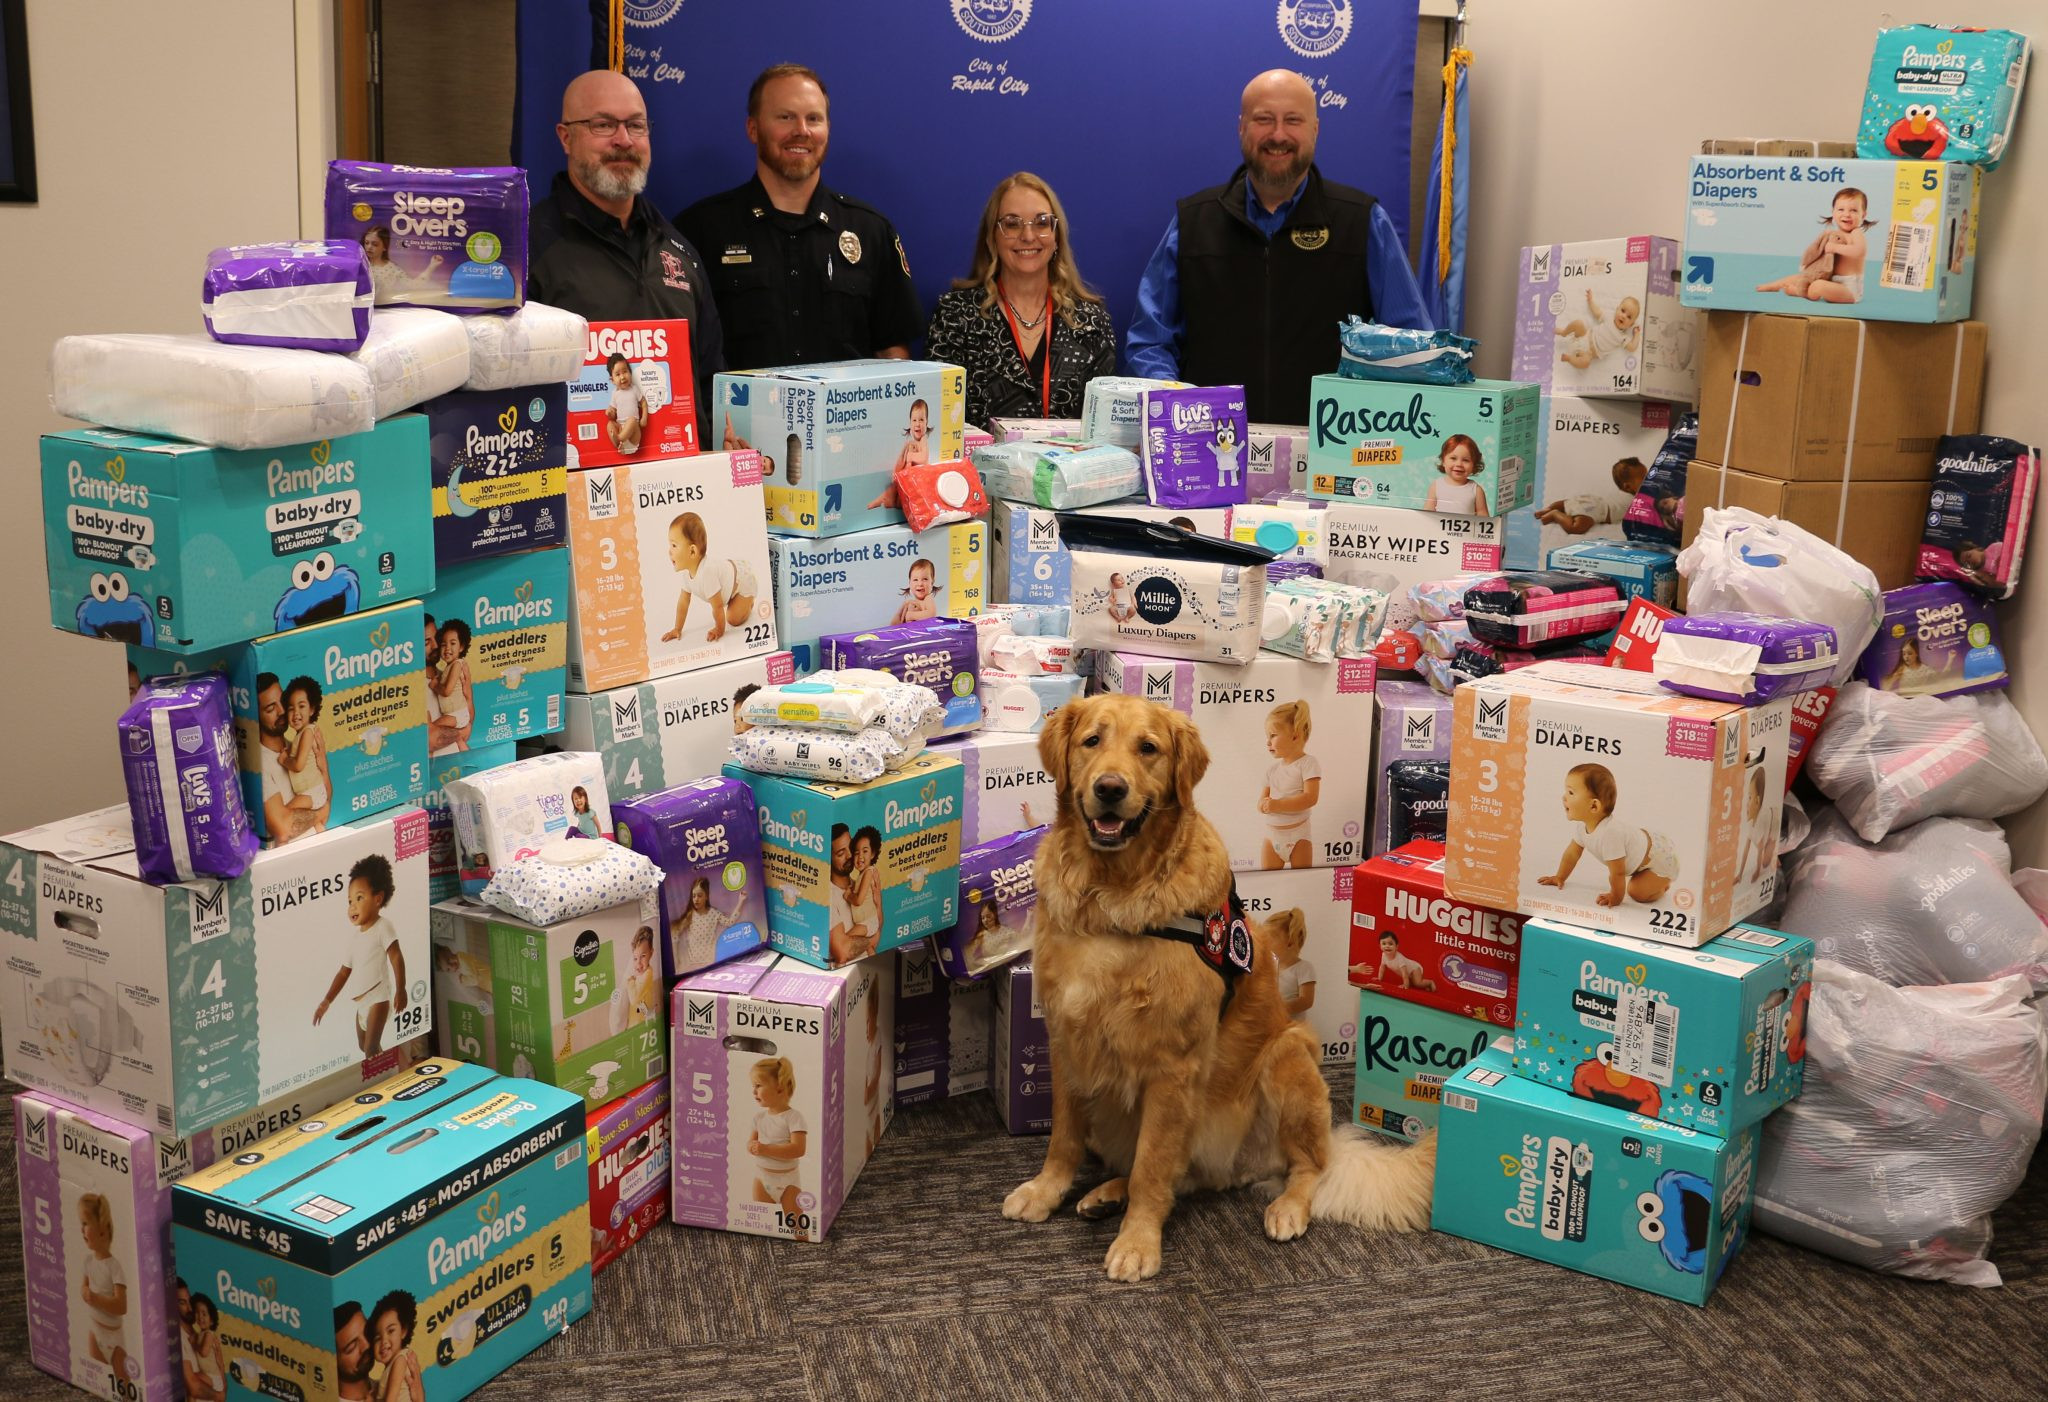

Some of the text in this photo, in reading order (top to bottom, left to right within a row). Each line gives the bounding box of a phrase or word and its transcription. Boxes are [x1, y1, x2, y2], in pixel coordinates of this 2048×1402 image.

[961, 11, 1022, 35] SOUTH DAKOTA
[1287, 27, 1341, 50] SOUTH DAKOTA
[654, 64, 685, 83] City
[969, 58, 1008, 75] City of
[952, 75, 1029, 96] Rapid City
[1320, 90, 1348, 109] City
[1963, 125, 1970, 134] 5
[1693, 163, 1845, 183] Absorbent & Soft
[1922, 169, 1938, 190] 5
[1693, 182, 1757, 199] Diapers
[393, 191, 465, 220] Sleep
[391, 214, 468, 237] Overs
[492, 266, 503, 275] 22
[1532, 294, 1540, 316] 1
[570, 382, 608, 393] SNUGGLERS
[954, 376, 963, 395] 5
[1613, 375, 1632, 387] 164
[826, 380, 916, 406] Absorbent & Soft
[826, 407, 868, 425] Diapers
[1479, 398, 1493, 417] 5
[1317, 392, 1432, 447] Rascals
[1556, 420, 1620, 435] DIAPERS
[466, 425, 533, 457] Pampers
[684, 424, 693, 442] 1
[952, 430, 961, 440] 112
[660, 442, 670, 452] 96
[1364, 440, 1391, 449] PREMIUM
[1357, 450, 1397, 463] DIAPERS
[736, 460, 750, 472] $18
[68, 460, 149, 509] Pampers
[267, 459, 355, 498] Pampers
[541, 473, 548, 485] 5
[638, 481, 673, 492] PREMIUM
[639, 486, 704, 508] DIAPERS
[1377, 484, 1391, 492] 64
[540, 507, 549, 516] 50
[1330, 522, 1378, 532] PREMIUM
[1440, 519, 1495, 534] 1152 12
[968, 533, 979, 553] 5
[1330, 533, 1450, 555] BABY WIPES
[383, 554, 390, 566] 5
[600, 538, 618, 571] 3
[789, 540, 919, 568] Absorbent & Soft
[1329, 550, 1418, 563] FRAGRANCE-FREE
[1466, 551, 1482, 561] $10
[1033, 556, 1052, 579] 6
[1227, 568, 1234, 576] 2
[382, 578, 392, 589] 78
[964, 587, 979, 599] 168
[1140, 591, 1176, 606] Millie
[161, 598, 168, 611] 5
[1916, 603, 1964, 625] Sleep
[160, 625, 172, 635] 78
[745, 624, 770, 643] 222
[1117, 624, 1196, 642] Luxury Diapers
[1918, 619, 1967, 641] Overs
[904, 650, 952, 670] Sleep
[1221, 648, 1232, 656] 31
[325, 641, 414, 684] Pampers
[771, 666, 785, 677] $17
[1344, 669, 1361, 679] $12
[663, 696, 699, 709] PREMIUM
[1200, 689, 1275, 704] DIAPERS
[664, 698, 729, 727] DIAPERS
[615, 723, 641, 733] Member's
[1475, 724, 1505, 734] Member's
[1536, 719, 1583, 733] PREMIUM
[1675, 729, 1696, 741] $18
[180, 734, 200, 744] OPEN
[1404, 738, 1432, 747] Member's
[1536, 729, 1622, 756] DIAPERS
[828, 757, 842, 767] 96
[985, 765, 1024, 776] PREMIUM
[410, 763, 421, 783] 5
[625, 758, 643, 789] 4
[1478, 760, 1499, 793] 3
[351, 795, 368, 811] 58
[885, 796, 953, 834] Pampers
[400, 827, 416, 842] $17
[1325, 841, 1352, 858] 160
[6, 858, 26, 897] 4
[43, 873, 75, 890] PREMIUM
[260, 876, 306, 898] PREMIUM
[262, 873, 344, 917] DIAPERS
[1759, 880, 1773, 898] 222
[43, 883, 104, 915] DIAPERS
[942, 898, 951, 913] 5
[1385, 886, 1518, 946] HUGGIES
[193, 917, 227, 934] Member's
[896, 924, 909, 938] 58
[1652, 928, 1682, 938] DIAPERS
[771, 930, 784, 944] 58
[811, 936, 820, 951] 5
[1435, 932, 1516, 962] little movers
[201, 960, 227, 998] 4
[574, 973, 588, 1004] 5
[737, 1003, 782, 1015] PREMIUM
[394, 1007, 422, 1034] 198
[686, 1022, 716, 1032] Member's
[737, 1012, 820, 1036] DIAPERS
[396, 1025, 420, 1041] DIAPERS
[640, 1029, 657, 1052] 78
[1321, 1042, 1349, 1057] 160
[1323, 1054, 1346, 1062] DIAPERS
[1744, 1003, 1764, 1096] Pampers
[692, 1072, 714, 1104] 5
[1704, 1083, 1715, 1098] 6
[1701, 1109, 1716, 1119] 64
[63, 1123, 98, 1144] PREMIUM
[222, 1104, 301, 1156] DIAPERS
[1624, 1141, 1635, 1152] 5
[1645, 1146, 1655, 1161] 78
[63, 1137, 129, 1175] DIAPERS
[1505, 1134, 1542, 1230] Pampers
[1569, 1179, 1580, 1214] BLOWOUT
[34, 1197, 53, 1235] 5
[1576, 1185, 1586, 1230] LEAKPROOF
[774, 1211, 810, 1230] 160
[204, 1208, 291, 1254] SAVE $45
[778, 1227, 808, 1237] DIAPERS
[427, 1204, 527, 1285] Pampers
[550, 1234, 562, 1259] 5
[216, 1269, 300, 1330] Pampers
[426, 1252, 535, 1334] swaddlers
[314, 1368, 324, 1382] 5
[107, 1374, 138, 1401] 160
